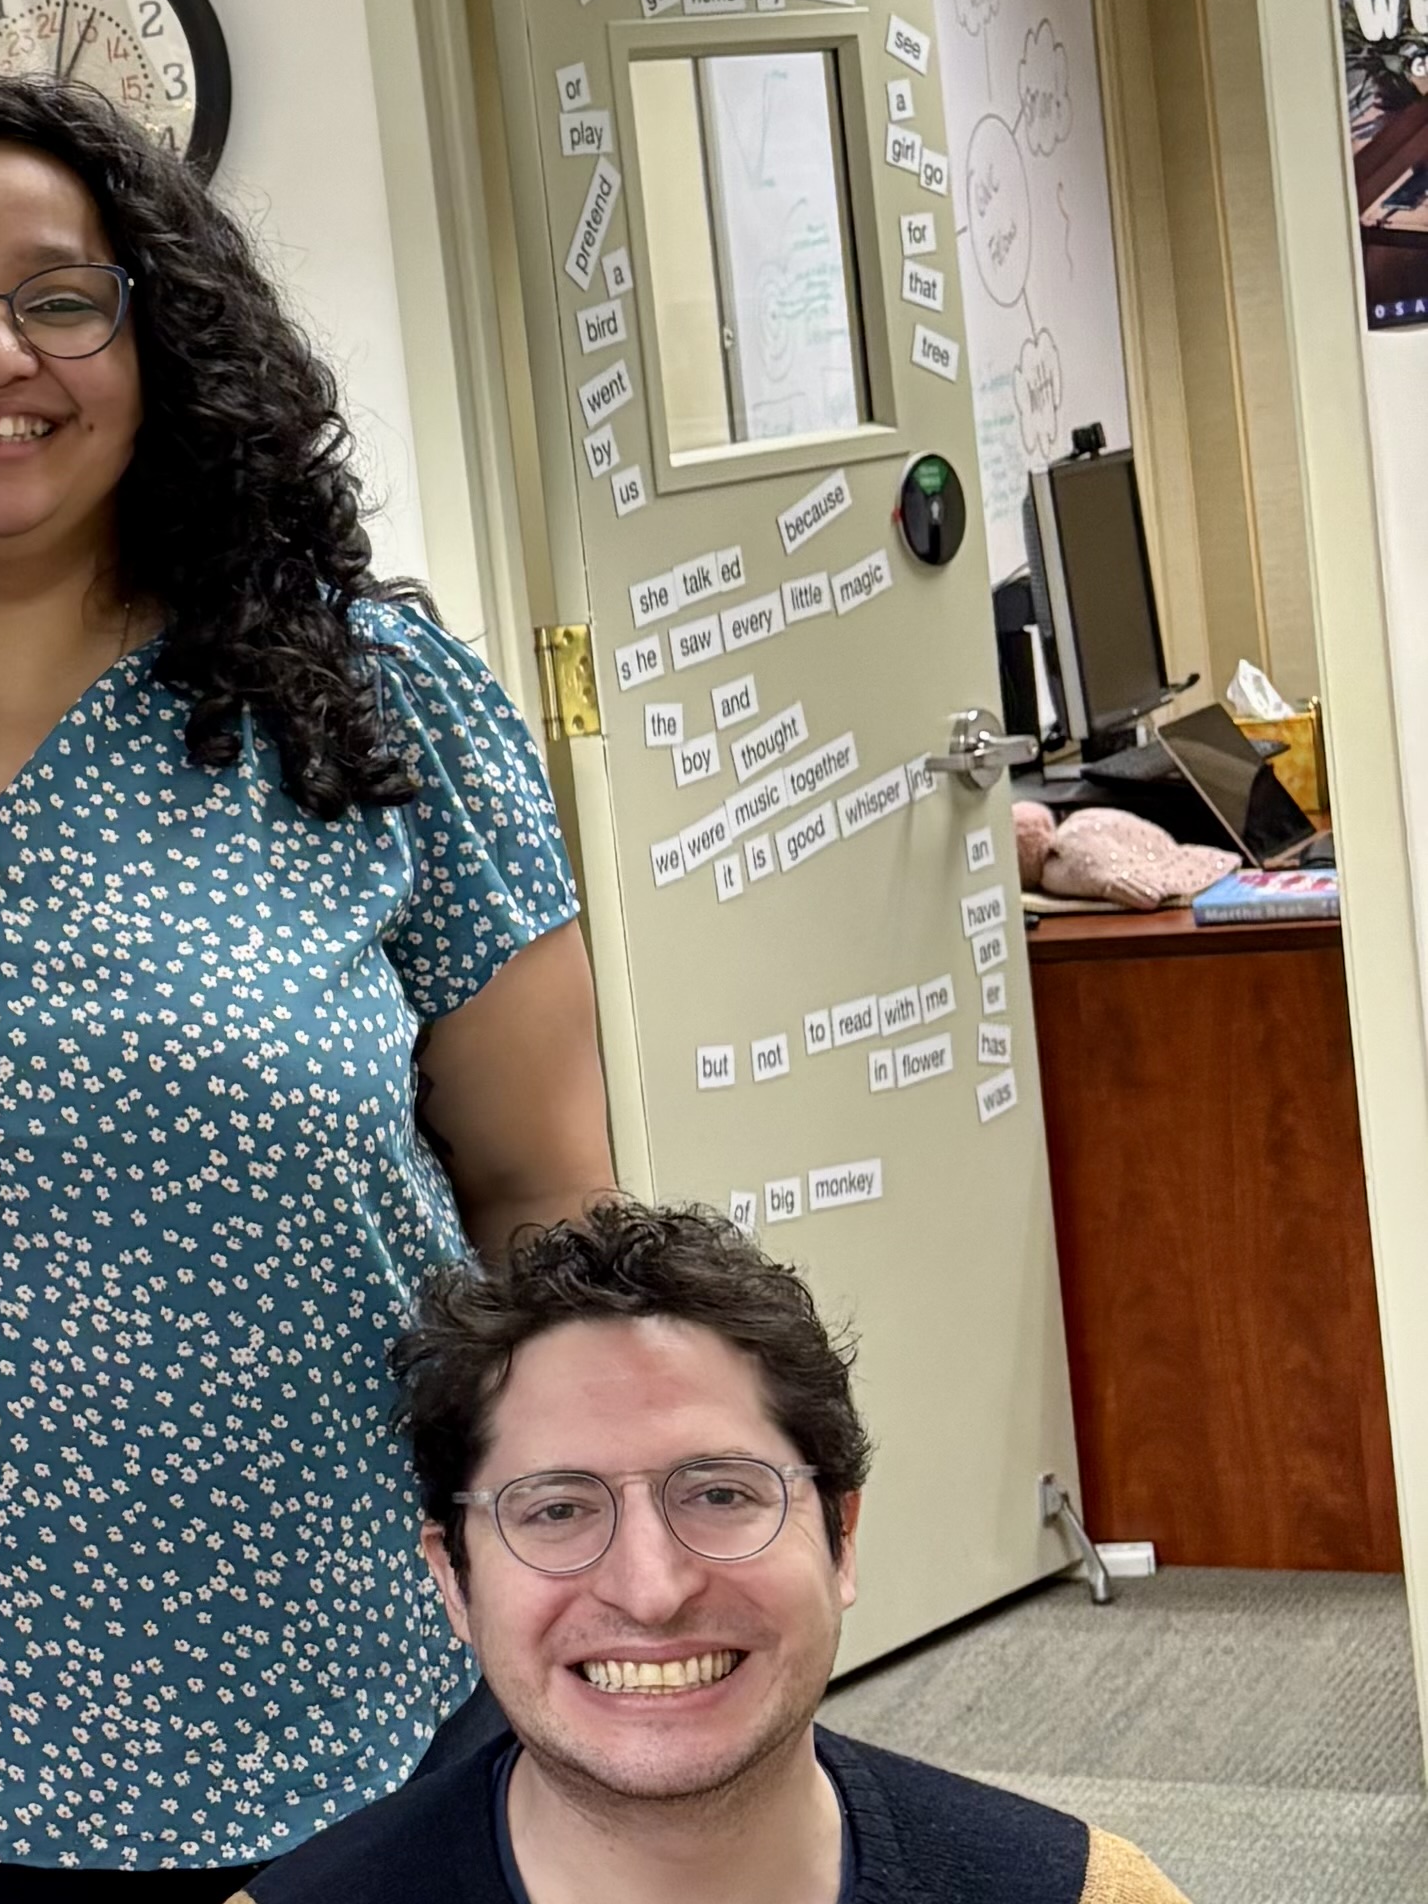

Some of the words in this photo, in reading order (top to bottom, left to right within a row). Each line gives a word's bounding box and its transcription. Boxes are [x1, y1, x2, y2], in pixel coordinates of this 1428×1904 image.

[139, 0, 164, 38] 2
[106, 36, 130, 63] 14
[894, 31, 921, 61] see
[121, 75, 143, 103] 15
[162, 63, 188, 101] 3
[565, 77, 581, 100] or
[896, 92, 906, 112] a
[569, 120, 604, 152] play
[892, 138, 915, 163] girl
[923, 163, 943, 186] go
[575, 173, 613, 276] pretend
[907, 221, 927, 244] for
[613, 265, 624, 286] a
[909, 272, 937, 301] that
[585, 310, 618, 343] bird
[922, 337, 950, 368] tree
[587, 371, 627, 414] went
[591, 439, 612, 468] by
[619, 479, 640, 505] us
[784, 484, 845, 543] because
[639, 585, 669, 616] she
[682, 566, 713, 597] talk
[721, 558, 742, 583] ed
[680, 629, 711, 657] saw
[732, 608, 773, 640] every
[790, 582, 823, 612] little
[840, 563, 884, 603] magic
[721, 685, 751, 716] and
[651, 713, 677, 737] the
[741, 716, 800, 770] thought
[681, 749, 711, 781] boy
[655, 850, 680, 875] we
[687, 821, 726, 858] were
[734, 783, 781, 826] music
[790, 744, 851, 796] together
[722, 864, 735, 888] it
[751, 844, 767, 870] is
[786, 814, 827, 859] good
[845, 781, 901, 825] whisper
[971, 839, 989, 861] an
[967, 897, 1000, 928] have
[979, 939, 1001, 964] are
[986, 984, 1000, 1004] er
[809, 1022, 826, 1044] to
[839, 1006, 873, 1036] read
[884, 996, 916, 1027] with
[926, 986, 949, 1013] me
[981, 1033, 1007, 1055] has
[702, 1054, 729, 1079] but
[757, 1043, 783, 1072] not
[874, 1060, 888, 1083] in
[902, 1047, 947, 1078] flower
[982, 1082, 1012, 1112] was
[733, 1199, 750, 1223] of
[770, 1187, 795, 1214] big
[815, 1170, 875, 1199] monkey
